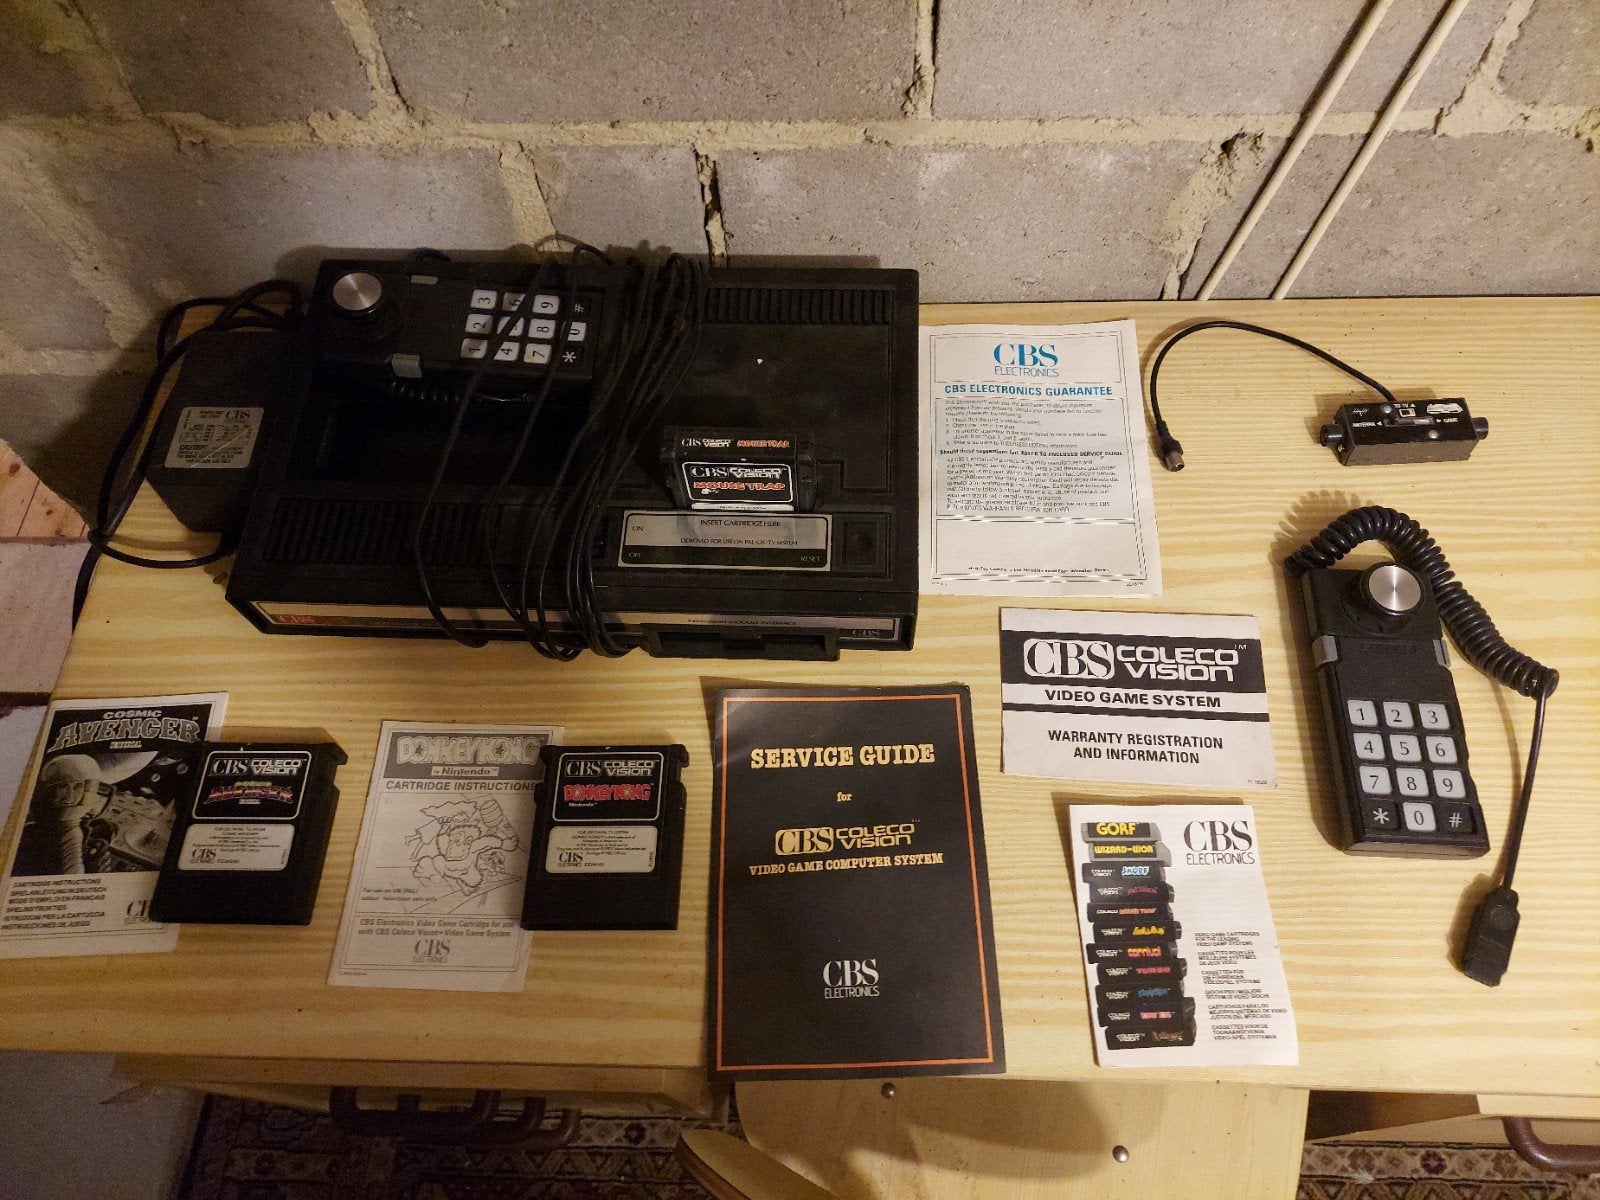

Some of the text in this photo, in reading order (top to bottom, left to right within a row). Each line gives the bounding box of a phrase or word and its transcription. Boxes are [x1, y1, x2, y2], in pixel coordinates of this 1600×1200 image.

[541, 301, 554, 309] 9
[473, 321, 487, 329] 2
[536, 325, 550, 333] 8
[500, 346, 513, 356] 4
[532, 350, 545, 359] 7
[993, 343, 1059, 367] CBS
[994, 365, 1059, 377] ELECTRONICS
[945, 385, 1112, 396] CBS ELECTRONICS GUARANTEE
[691, 467, 728, 477] CBS
[694, 481, 745, 490] MOUSE
[852, 629, 879, 637] CBS
[1025, 639, 1239, 679] CBS COLECO
[1125, 663, 1234, 682] VISION
[1045, 690, 1221, 708] VIDEO GAME SYSTEM
[103, 710, 162, 719] COSMIC
[1357, 708, 1364, 720] 1
[1391, 709, 1402, 722] 2
[1428, 710, 1438, 724] 3
[50, 718, 201, 752] AVENGER
[1048, 730, 1223, 749] WARRANTY REGISTRATION
[397, 736, 540, 765] DONKEY KONG
[1364, 741, 1374, 754] 4
[1400, 741, 1410, 755] 5
[1435, 743, 1445, 757] 6
[750, 743, 935, 769] SERVICE GUIDE
[1074, 747, 1199, 764] AND INFORMATION
[213, 760, 248, 774] CBS
[566, 760, 601, 776] CBS
[607, 768, 651, 776] VISION
[386, 782, 536, 791] CARTRIDGE INSTRUCTIONS
[1369, 775, 1379, 789] 7
[1407, 777, 1417, 790] 8
[1443, 778, 1453, 792] 9
[564, 784, 651, 801] DONKEY KONG
[837, 792, 852, 802] for
[1414, 811, 1424, 825] 0
[1096, 821, 1136, 836] GORF
[776, 823, 915, 855] CBS COLECO
[840, 834, 911, 850] VISION
[1184, 820, 1253, 852] CBS
[192, 849, 216, 859] CBS
[559, 852, 583, 862] CBS
[1187, 852, 1255, 866] ELECTRONICS
[749, 852, 943, 875] VIDEO GAME COMPUTER SYSTEM
[377, 919, 415, 927] Electronics
[459, 921, 490, 929] Cartridge
[415, 939, 450, 956] CBS
[822, 958, 880, 987] CBS
[824, 986, 880, 999] ELECTRONICS
